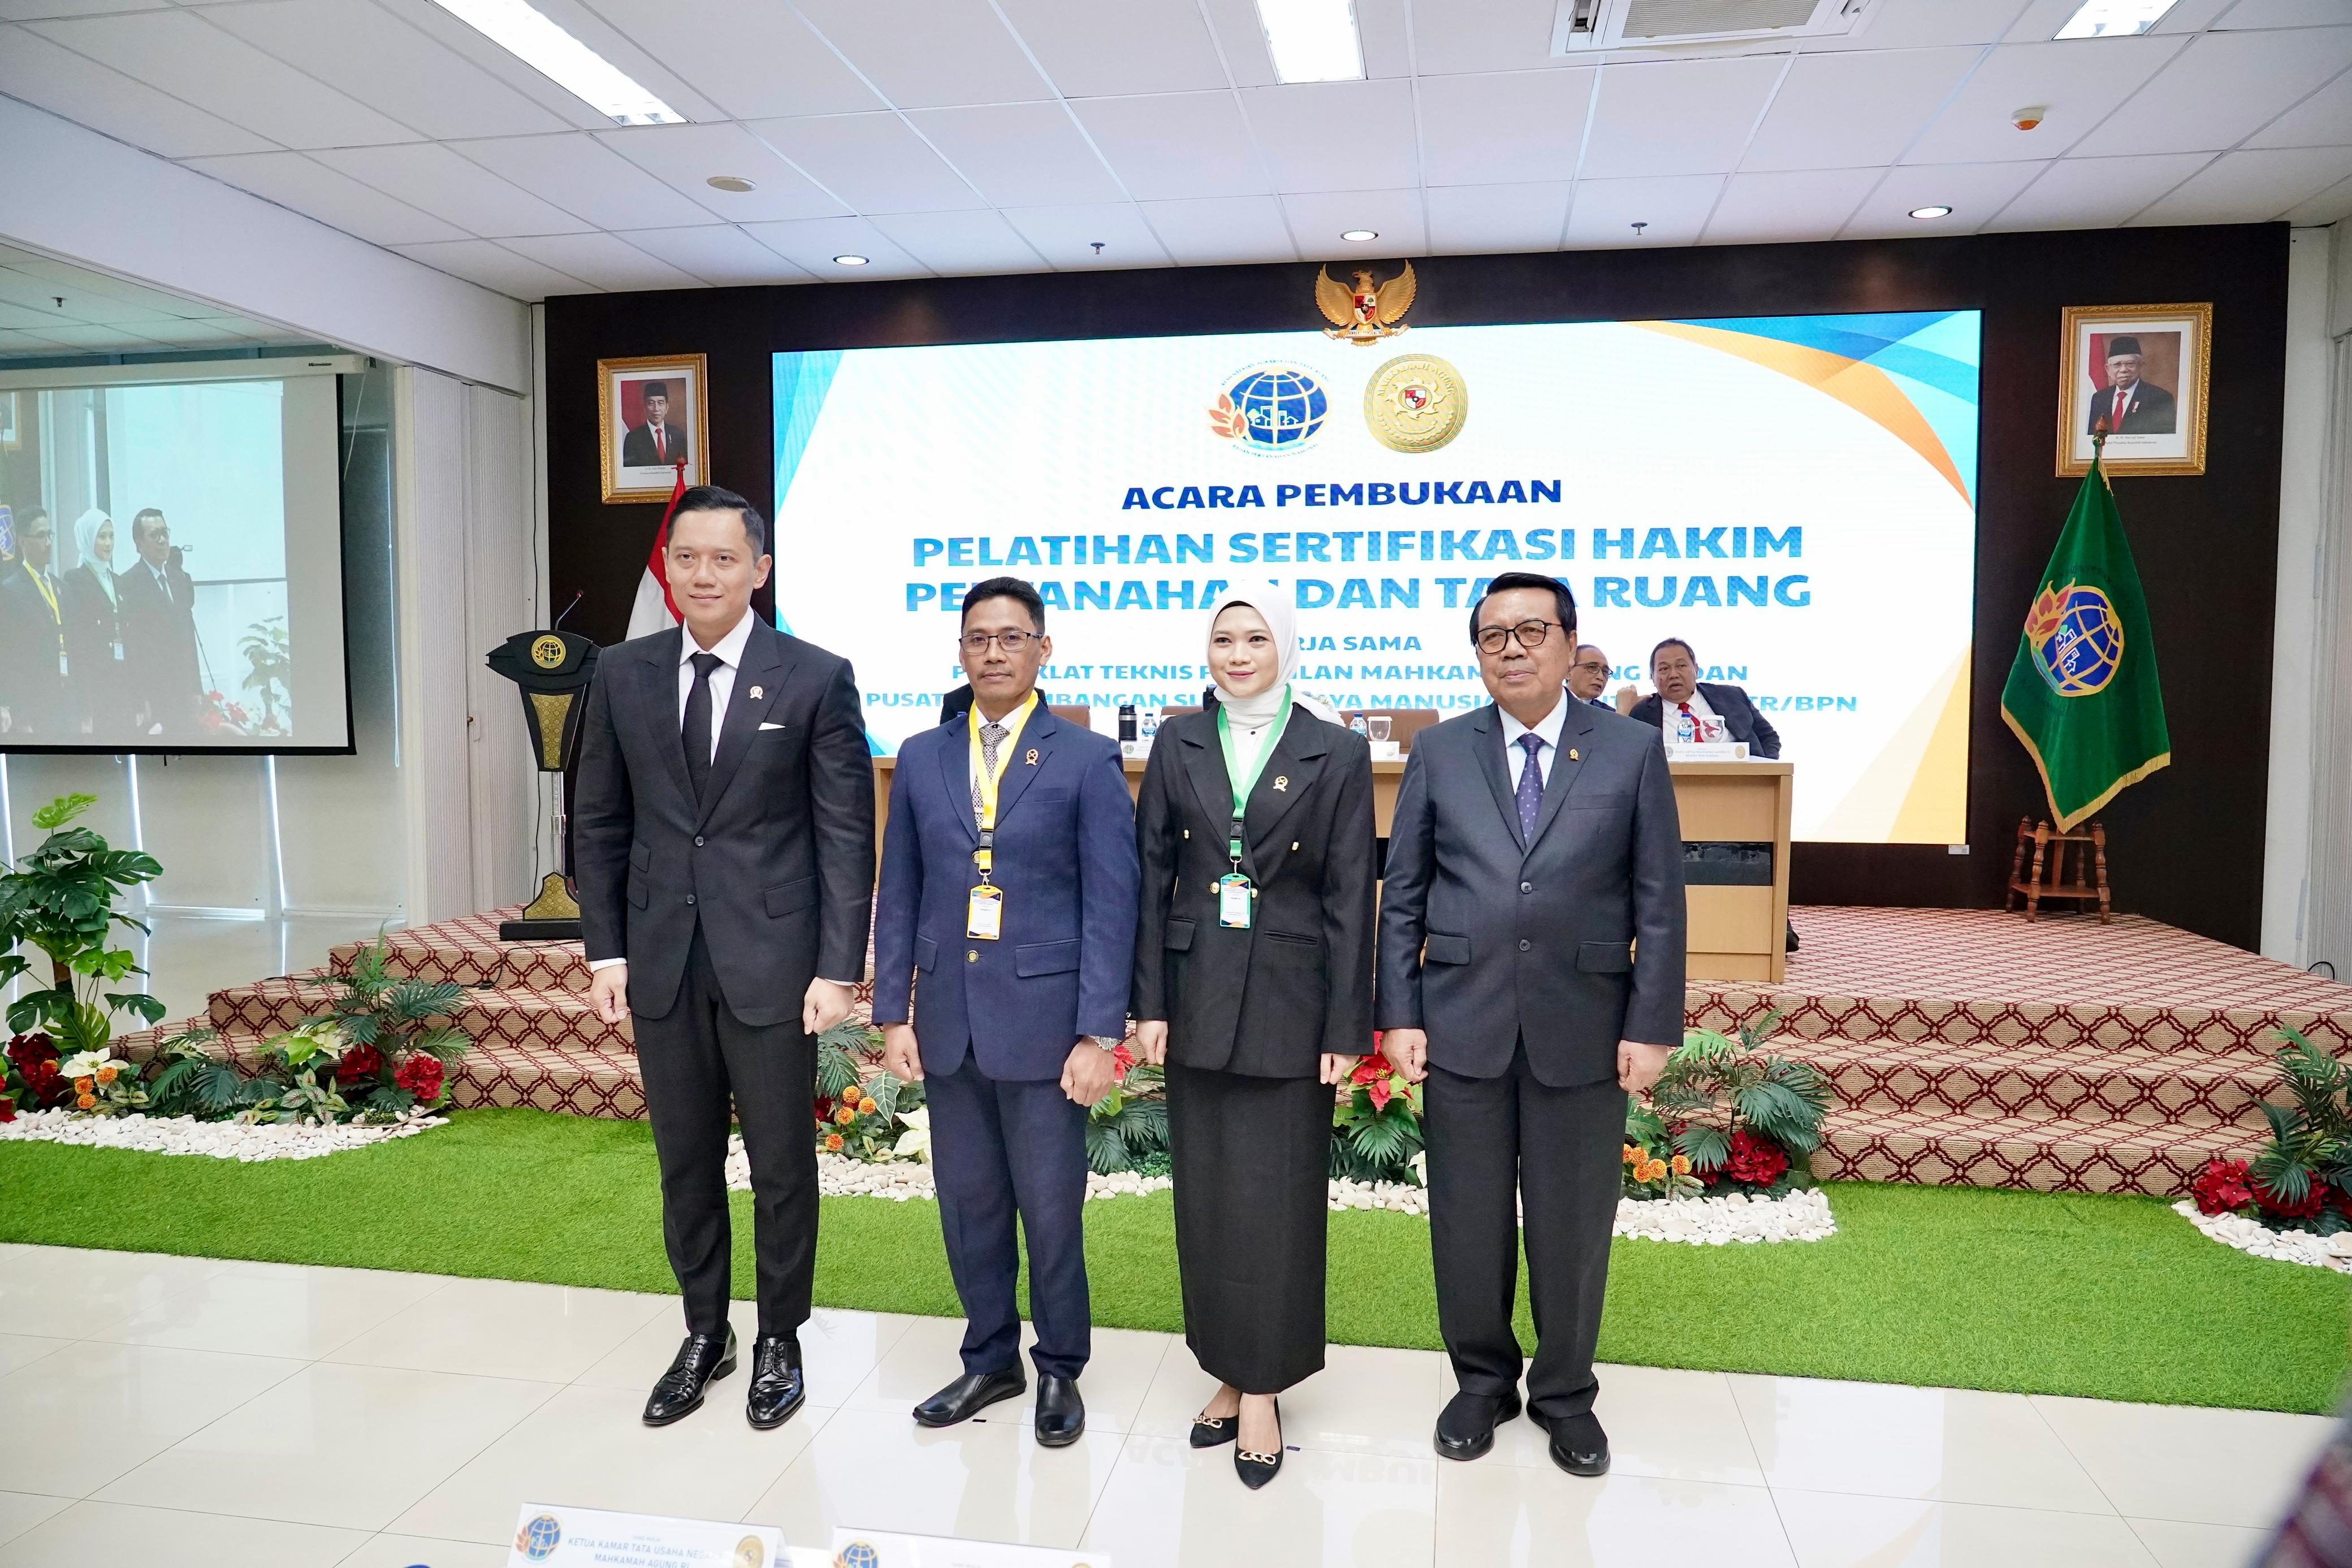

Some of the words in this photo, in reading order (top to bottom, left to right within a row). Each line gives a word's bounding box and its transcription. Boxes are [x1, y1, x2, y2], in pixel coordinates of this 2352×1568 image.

[1122, 485, 1265, 509] ACARA
[1277, 480, 1561, 506] PEMBUKAAN
[913, 533, 1214, 566] PELATIHAN
[1229, 529, 1575, 562] SERTIFIKASI
[1593, 526, 1802, 559] HAKIM
[1296, 578, 1420, 609] DAN
[1594, 574, 1811, 608] RUANG
[1343, 636, 1422, 651] SAMA
[1100, 665, 1193, 679] TEKNIS
[1361, 666, 1481, 680] MAHKAM
[866, 693, 944, 707] PUSAT
[568, 1537, 595, 1548] KETUA
[598, 1540, 629, 1551] KAMAR
[631, 1543, 651, 1554] TATA
[654, 1546, 684, 1557] USAHA
[594, 1553, 646, 1567] MAHKAMAH
[647, 1558, 677, 1568] AGUNG
